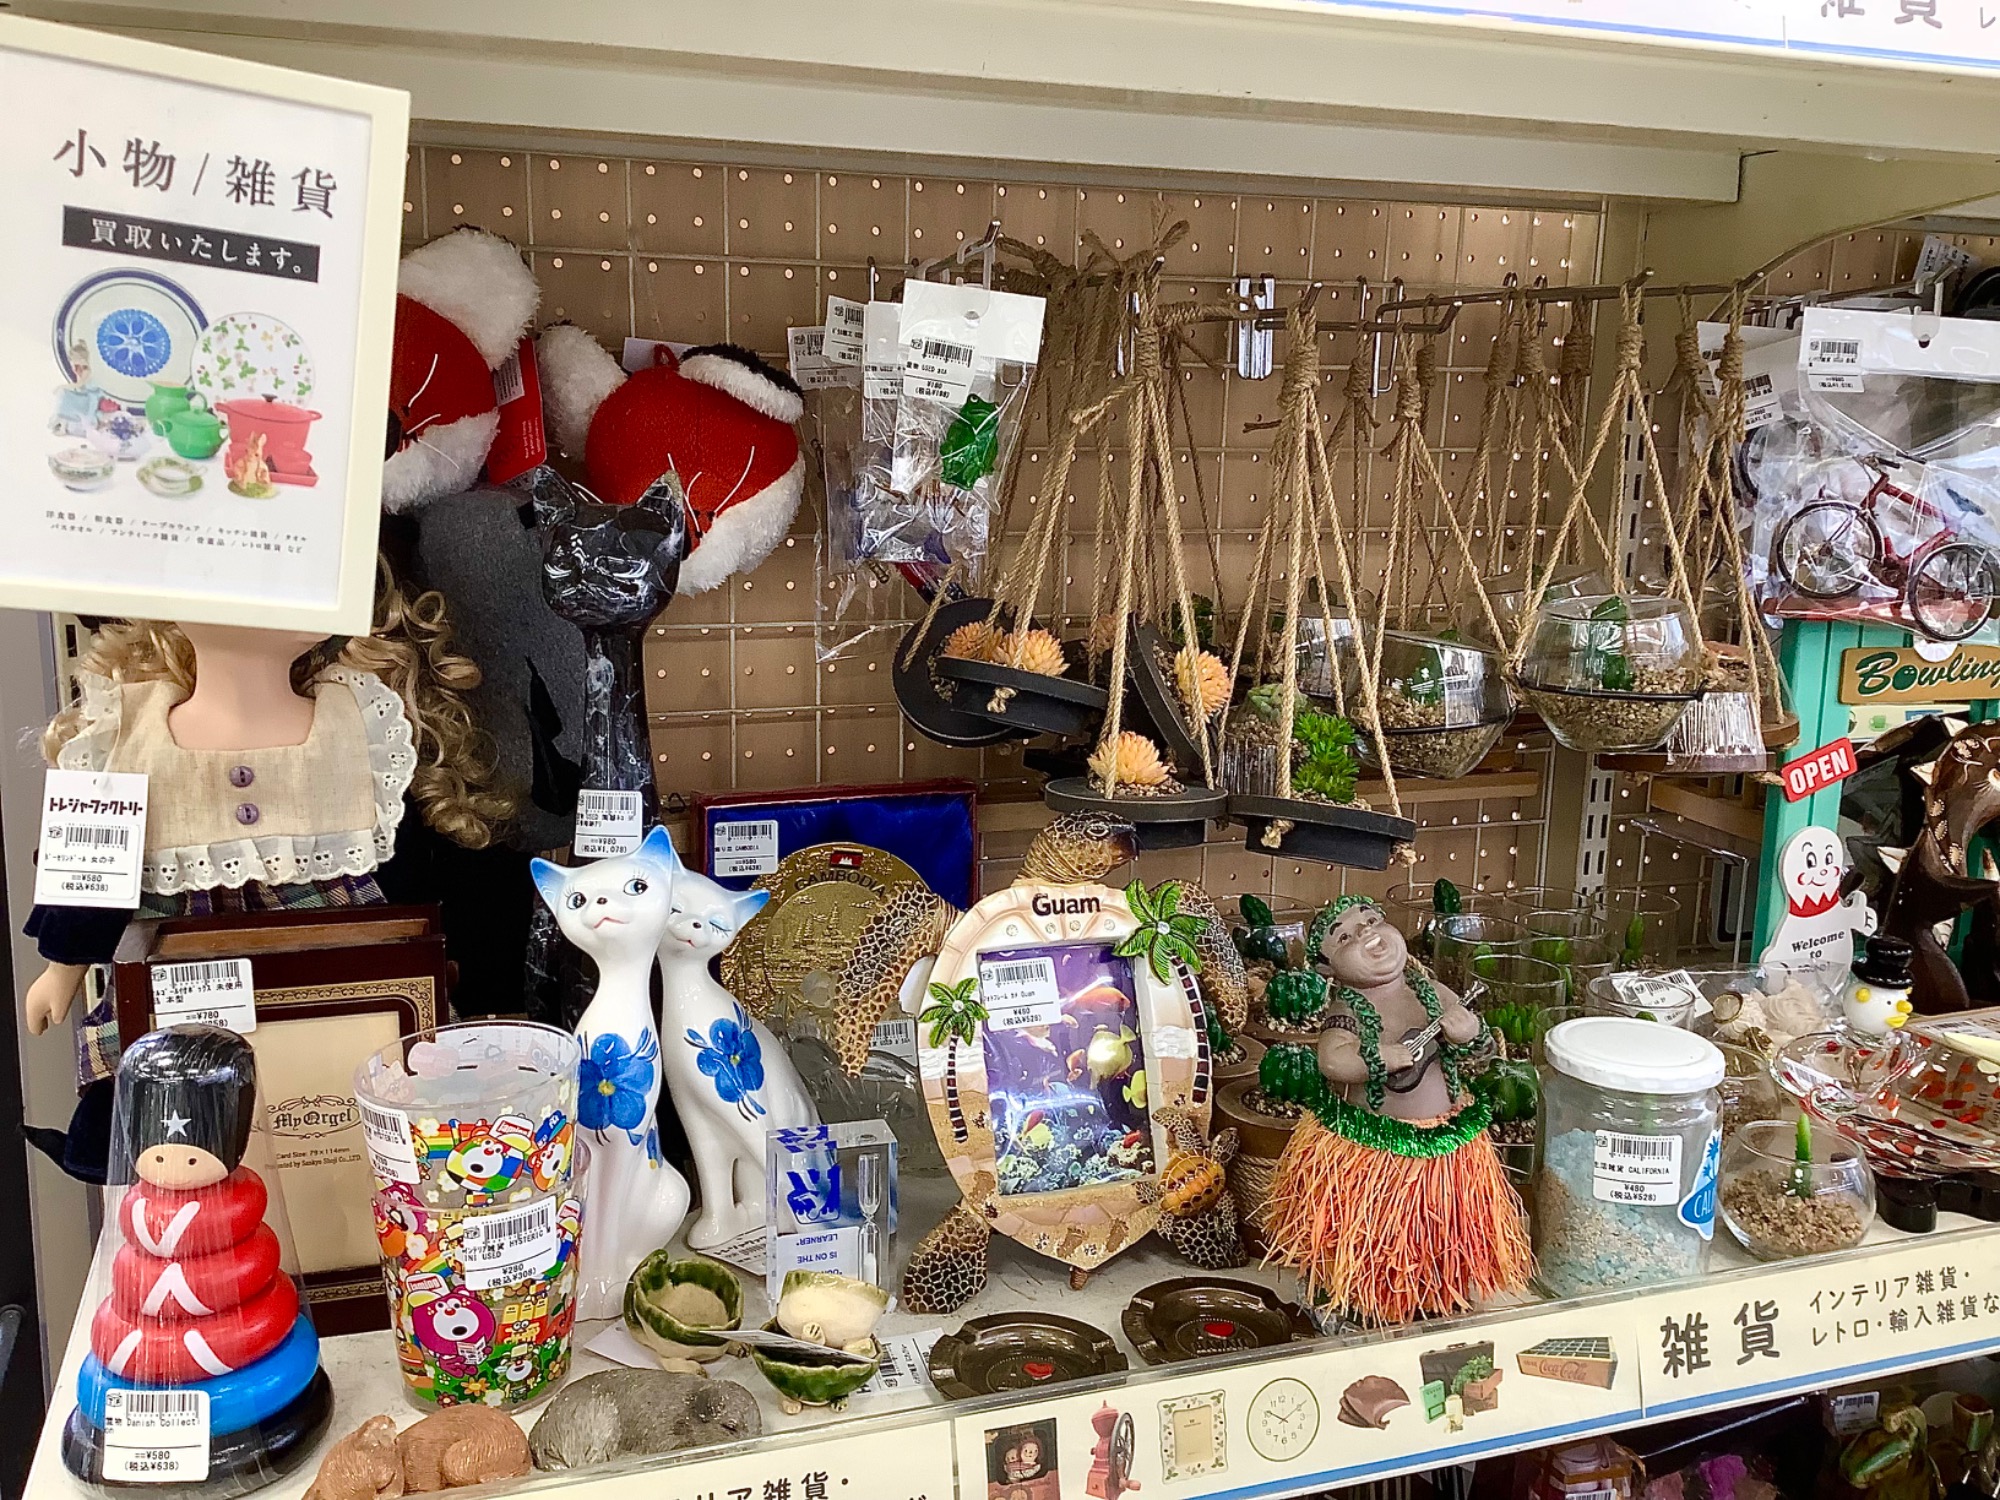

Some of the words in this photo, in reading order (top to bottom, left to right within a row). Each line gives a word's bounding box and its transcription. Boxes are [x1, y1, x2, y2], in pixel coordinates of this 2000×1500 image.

[53, 128, 337, 218] 小物/雑貨
[91, 218, 302, 274] 買取いたします。
[1789, 747, 1850, 795] OPEN
[50, 798, 143, 816] トレジャーファクトリー
[90, 856, 116, 865] 女の子
[61, 882, 108, 892] (税込¥638)
[794, 869, 887, 898] CAMBODIA
[1032, 892, 1101, 917] Guam
[1791, 930, 1845, 953] Welcome
[1810, 949, 1822, 959] to
[216, 982, 244, 991] 未使用
[1021, 990, 1036, 998] Guam
[276, 1152, 291, 1160] Card
[1628, 1166, 1670, 1175] CALIFORNIA
[1624, 1184, 1646, 1192] ¥480
[1610, 1190, 1656, 1202] (税込¥528)
[510, 1230, 544, 1248] HYSTERIC
[482, 1251, 502, 1260] USED
[796, 1254, 814, 1264] THE
[815, 1252, 828, 1261] ON
[829, 1250, 838, 1260] IS
[502, 1263, 524, 1274] ¥280
[488, 1266, 536, 1288] (税込¥308)
[1660, 1300, 1780, 1378] 雑貨
[126, 1418, 156, 1427] Danish
[124, 1461, 180, 1472] (税込¥638)
